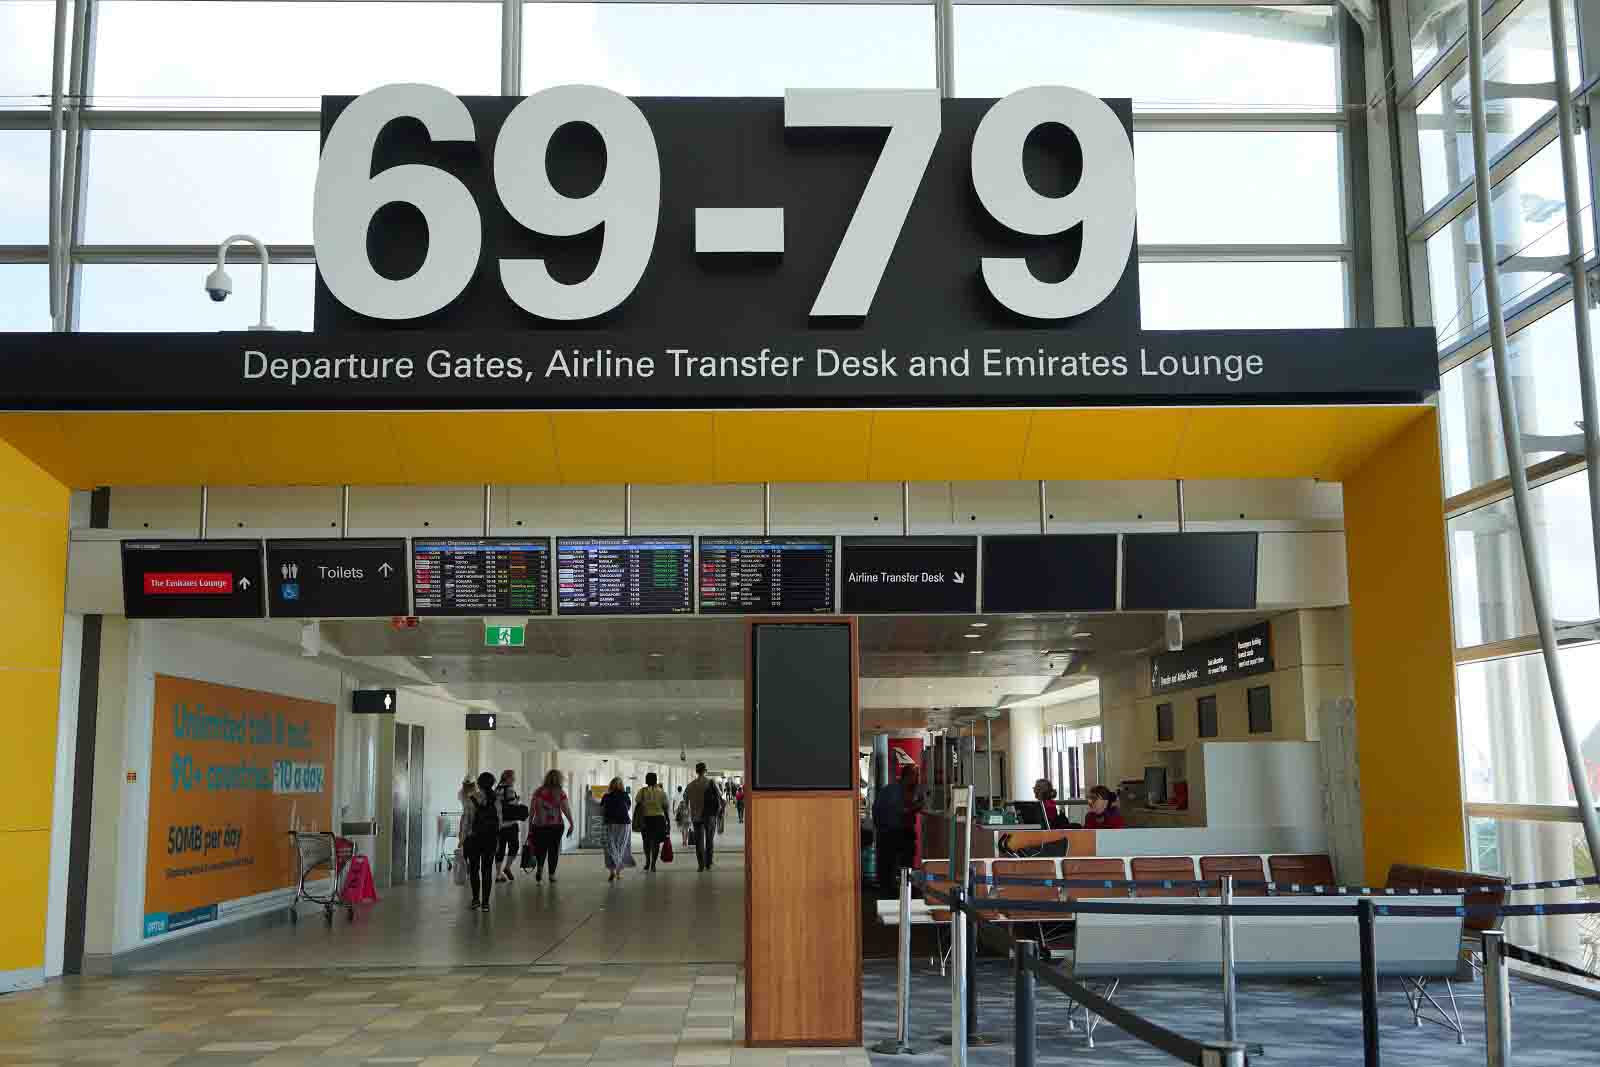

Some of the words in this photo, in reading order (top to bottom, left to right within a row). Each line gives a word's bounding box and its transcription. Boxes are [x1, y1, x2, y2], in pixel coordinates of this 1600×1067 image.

[243, 350, 414, 385] Departure
[426, 349, 533, 383] Gates,
[544, 349, 655, 378] Airline
[665, 348, 804, 377] Transfer
[816, 348, 898, 377] Desk
[908, 348, 970, 377] and
[983, 348, 1128, 377] Emirates
[1140, 348, 1264, 382] Lounge
[151, 579, 164, 587] The
[166, 579, 198, 587] Emirates
[199, 579, 227, 589] Lounge
[318, 566, 364, 579] Toilets
[848, 572, 879, 583] Airline
[881, 572, 919, 583] Transfer
[922, 572, 945, 583] Desk
[173, 751, 203, 792] 90+
[168, 824, 202, 856] 50MB
[203, 829, 222, 857] per
[224, 824, 242, 853] day
